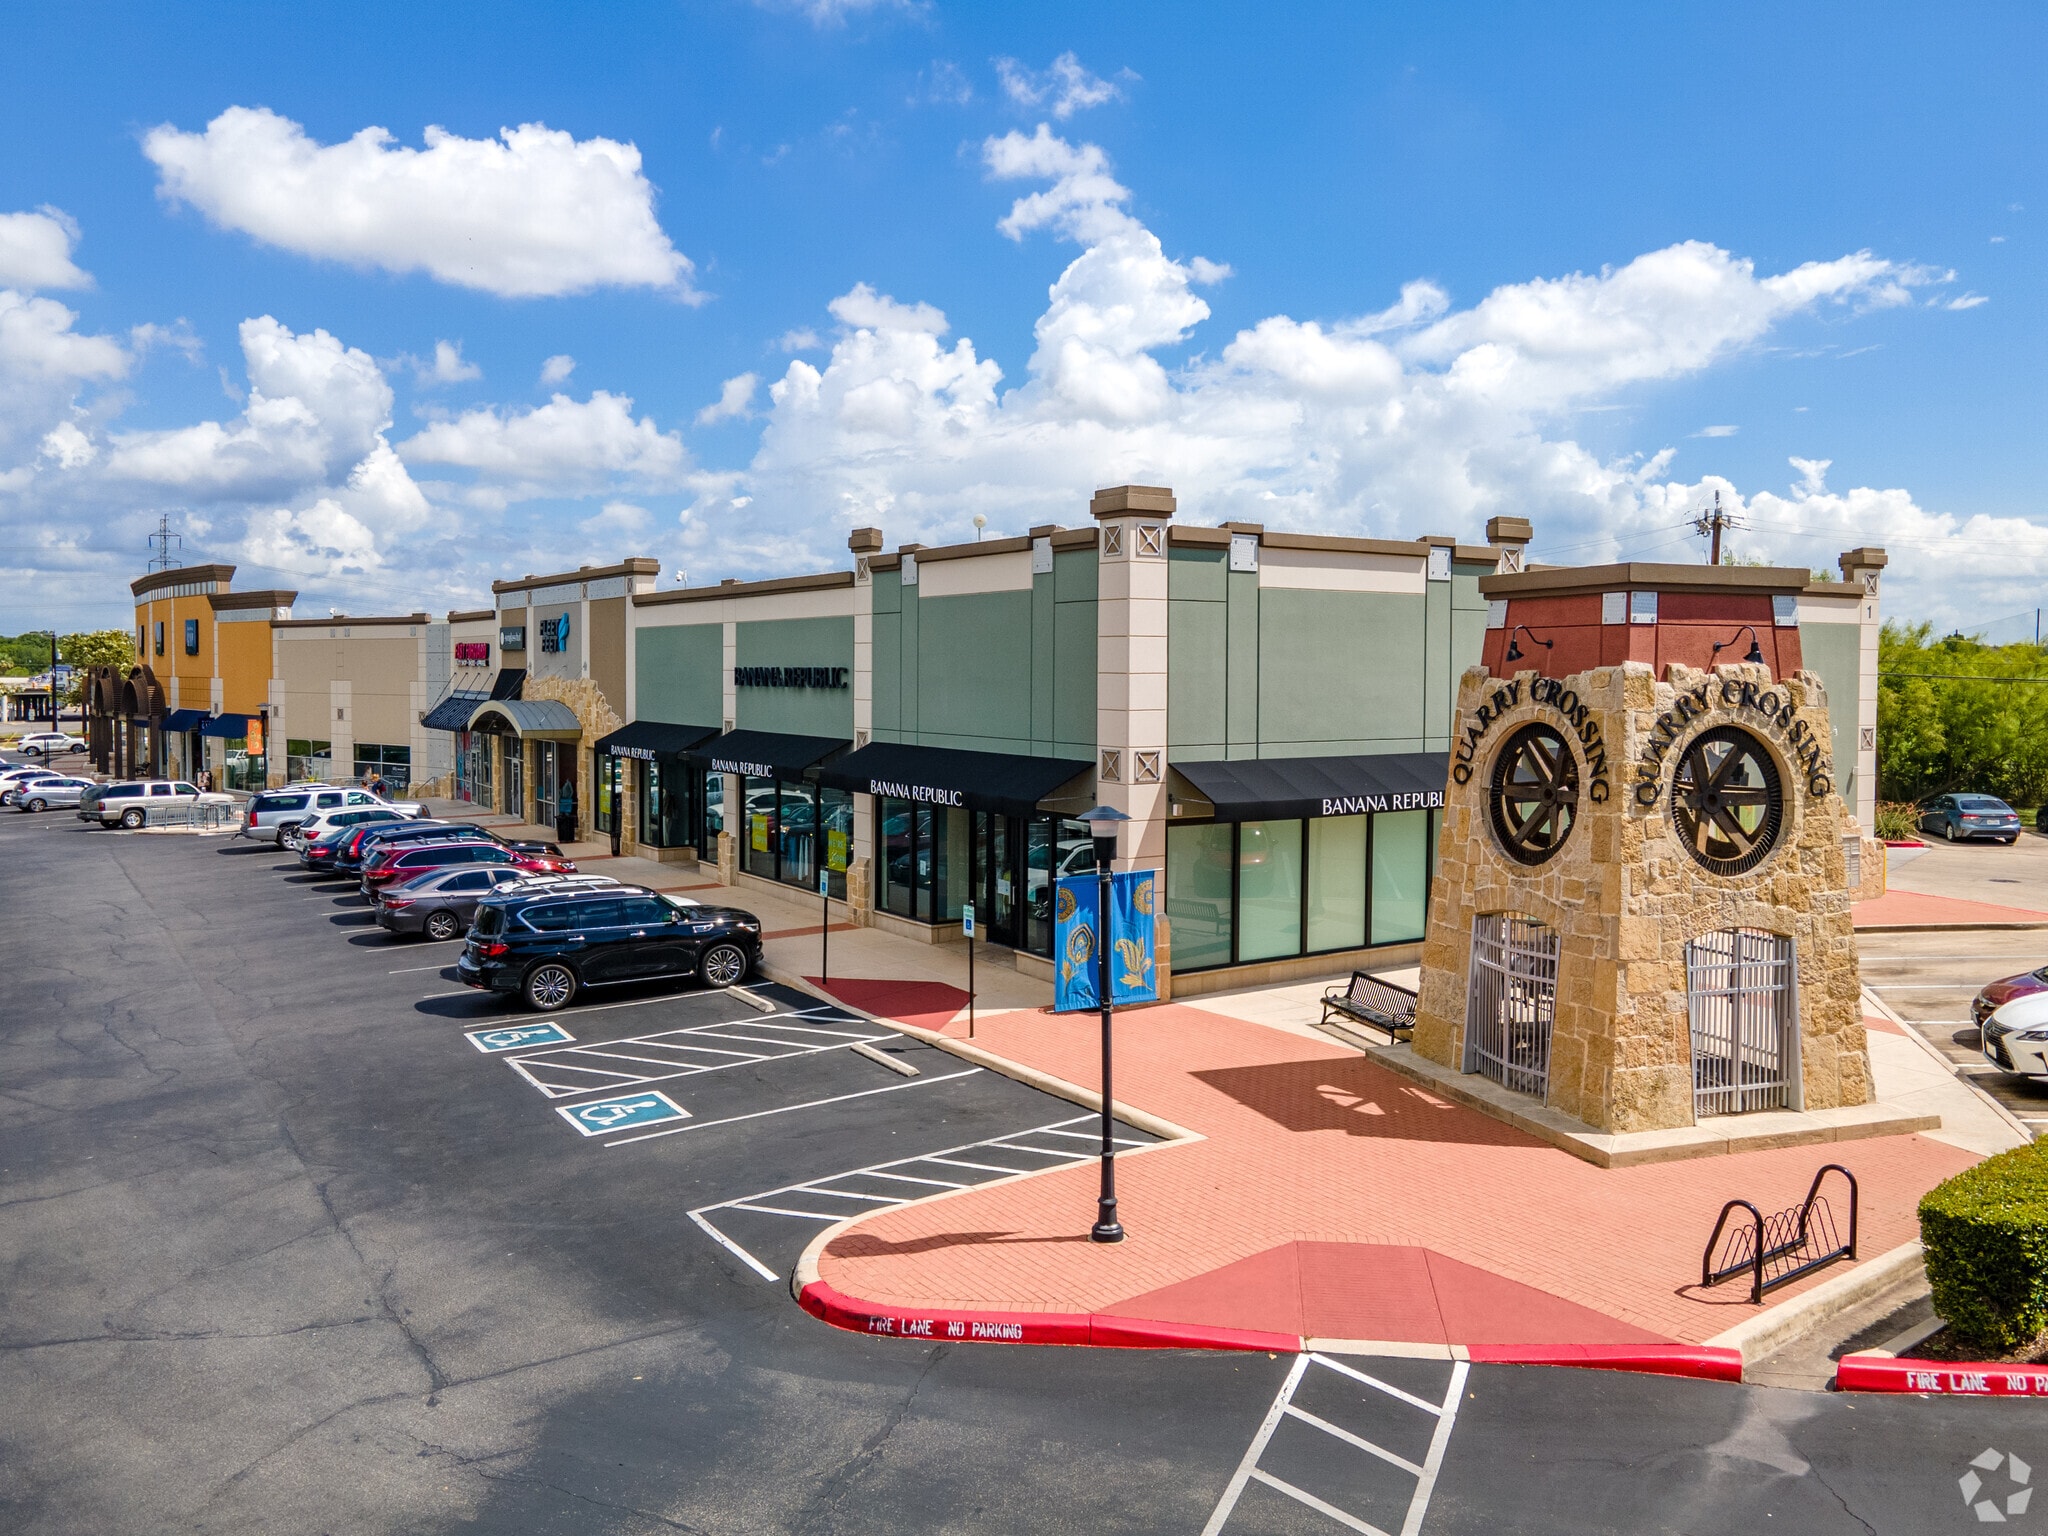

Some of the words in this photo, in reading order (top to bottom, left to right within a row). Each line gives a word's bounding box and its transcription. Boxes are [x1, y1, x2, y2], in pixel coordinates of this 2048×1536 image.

[540, 619, 561, 636] FLEET
[541, 635, 560, 653] FEET
[735, 666, 783, 687] BANANA
[783, 666, 848, 689] REPUBLIC
[1453, 679, 1521, 786] QUARRY
[1530, 678, 1610, 805] CROSSING
[1636, 683, 1712, 806] QUARRY
[1723, 679, 1831, 798] CROSSING
[610, 744, 631, 758] BANANA
[631, 746, 656, 761] REPUBLIC
[711, 758, 739, 774] BANANA
[739, 761, 773, 778] REPUBLIC
[870, 779, 910, 799] BANANA
[912, 785, 963, 807] REPUBLIC
[1322, 795, 1389, 816] BANANA
[868, 1316, 895, 1333] FIRE
[901, 1318, 934, 1336] LANE
[948, 1321, 965, 1337] NO
[972, 1322, 1022, 1339] PARKING
[1906, 1372, 1942, 1391] FIRE
[1949, 1373, 1991, 1392] LANE
[2006, 1375, 2028, 1391] NO
